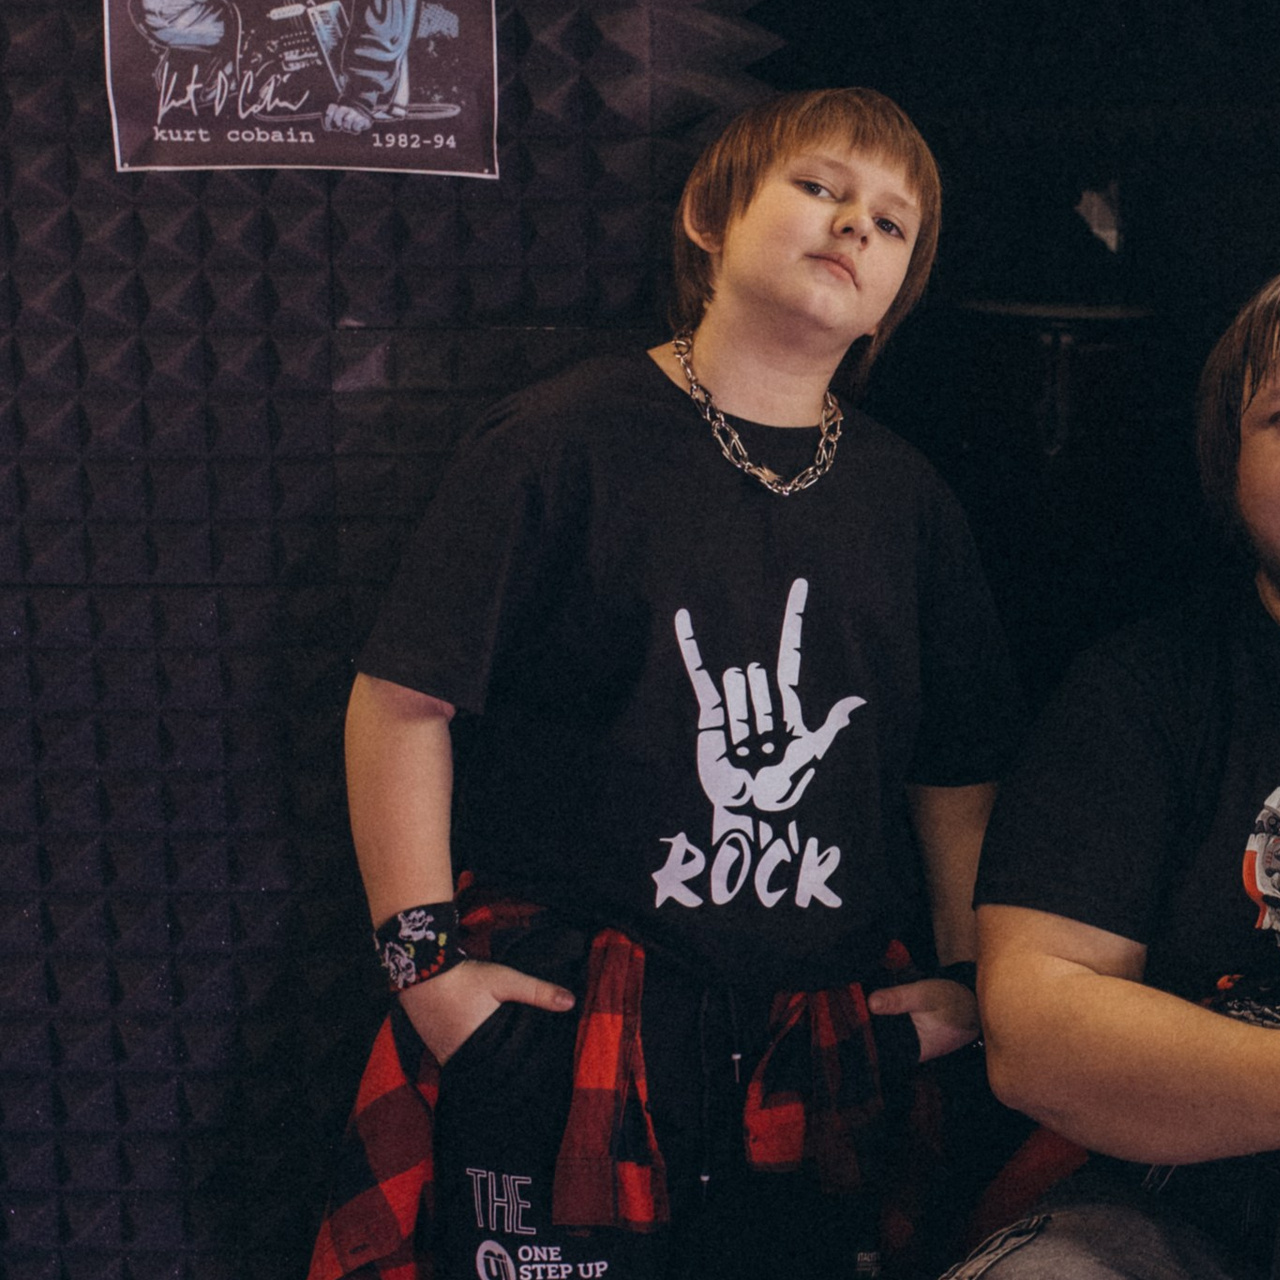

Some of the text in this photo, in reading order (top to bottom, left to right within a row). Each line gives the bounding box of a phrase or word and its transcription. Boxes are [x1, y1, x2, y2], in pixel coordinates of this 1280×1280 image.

[153, 125, 457, 149] kurt cobain 1982-94
[651, 831, 843, 909] ROCK
[466, 1167, 537, 1236] THE
[517, 1245, 562, 1262] ONE
[577, 1261, 609, 1279] UP
